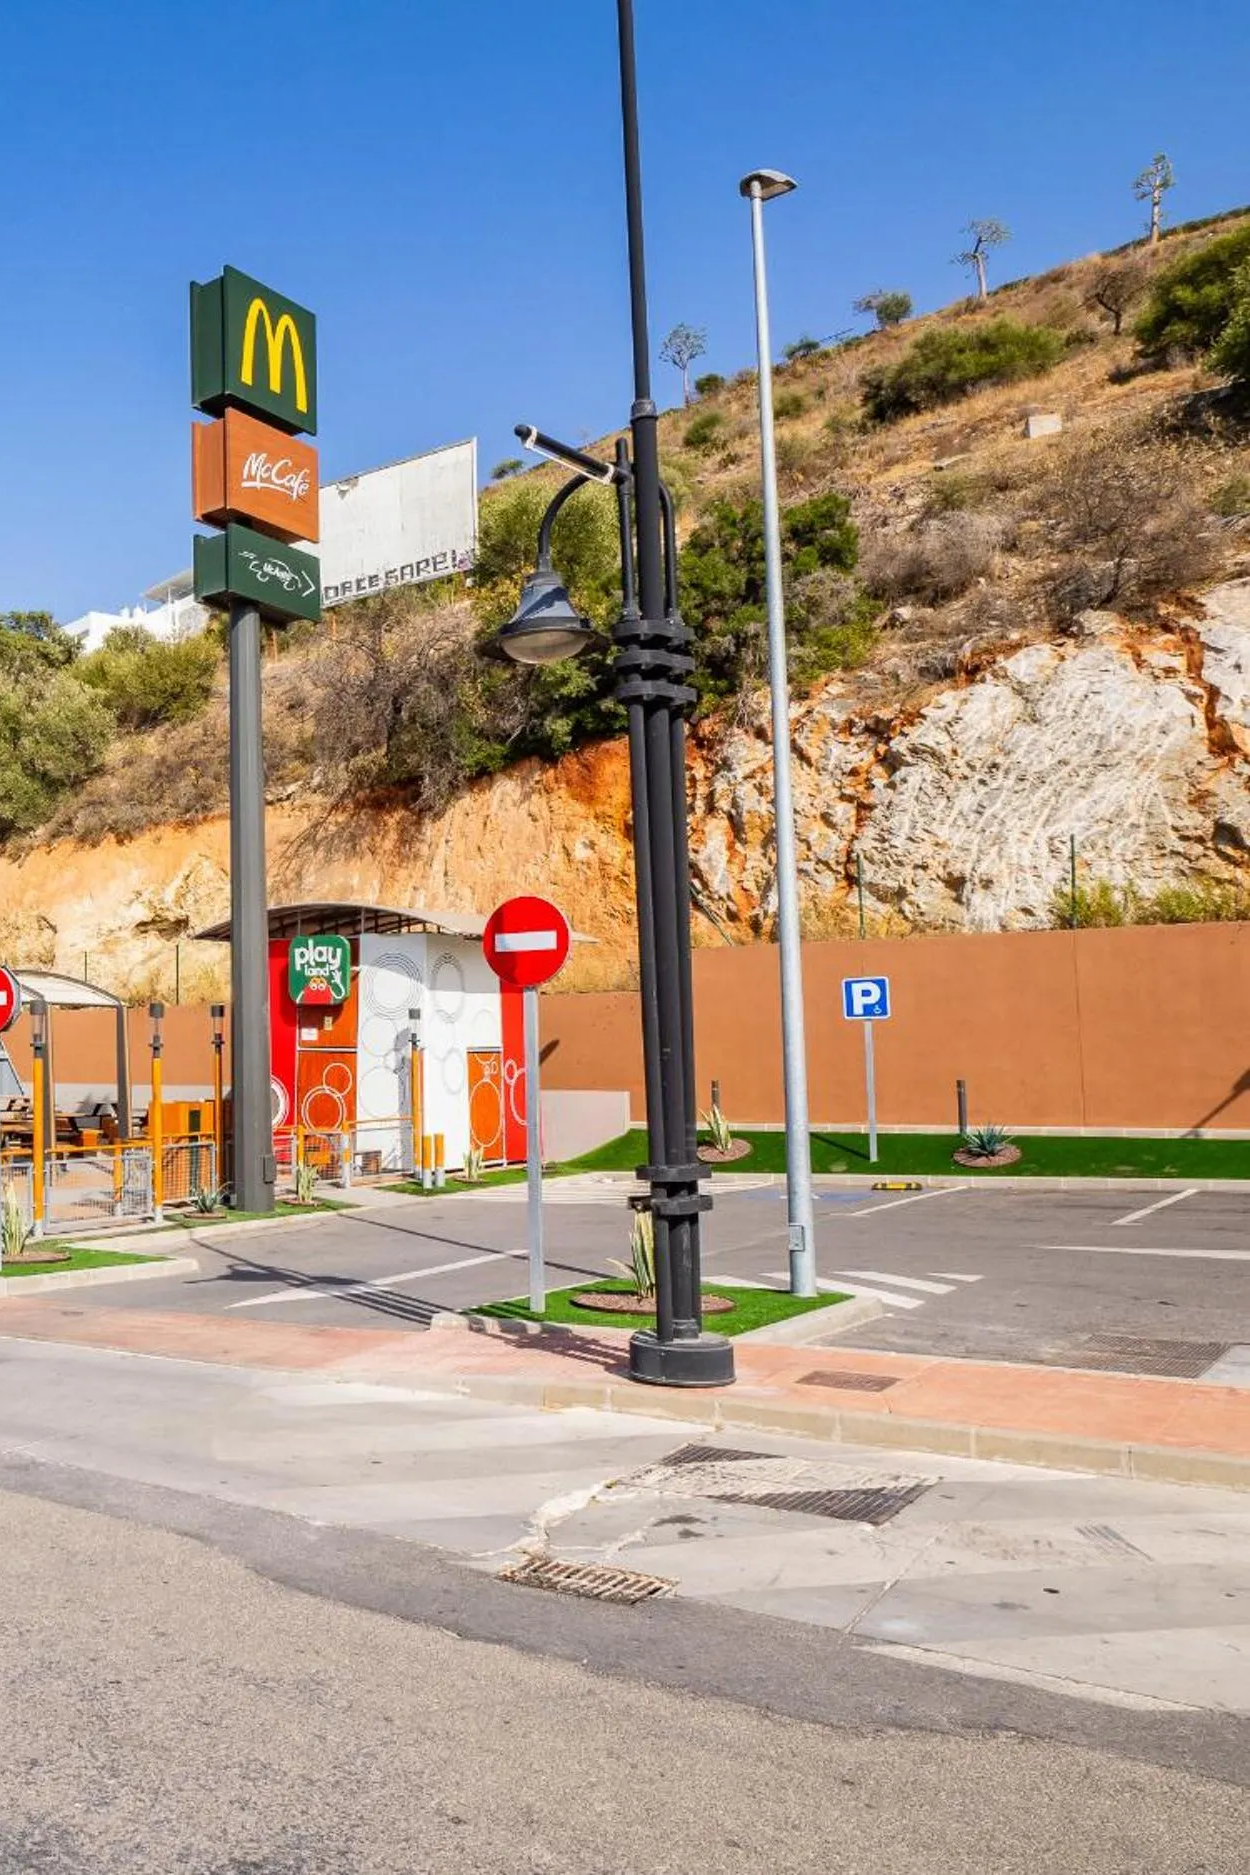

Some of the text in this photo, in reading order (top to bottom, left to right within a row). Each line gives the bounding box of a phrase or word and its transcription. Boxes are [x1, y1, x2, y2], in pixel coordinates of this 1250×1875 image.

[241, 298, 307, 414] M
[242, 453, 311, 501] McCafé
[294, 939, 342, 971] play
[851, 982, 881, 1015] P
